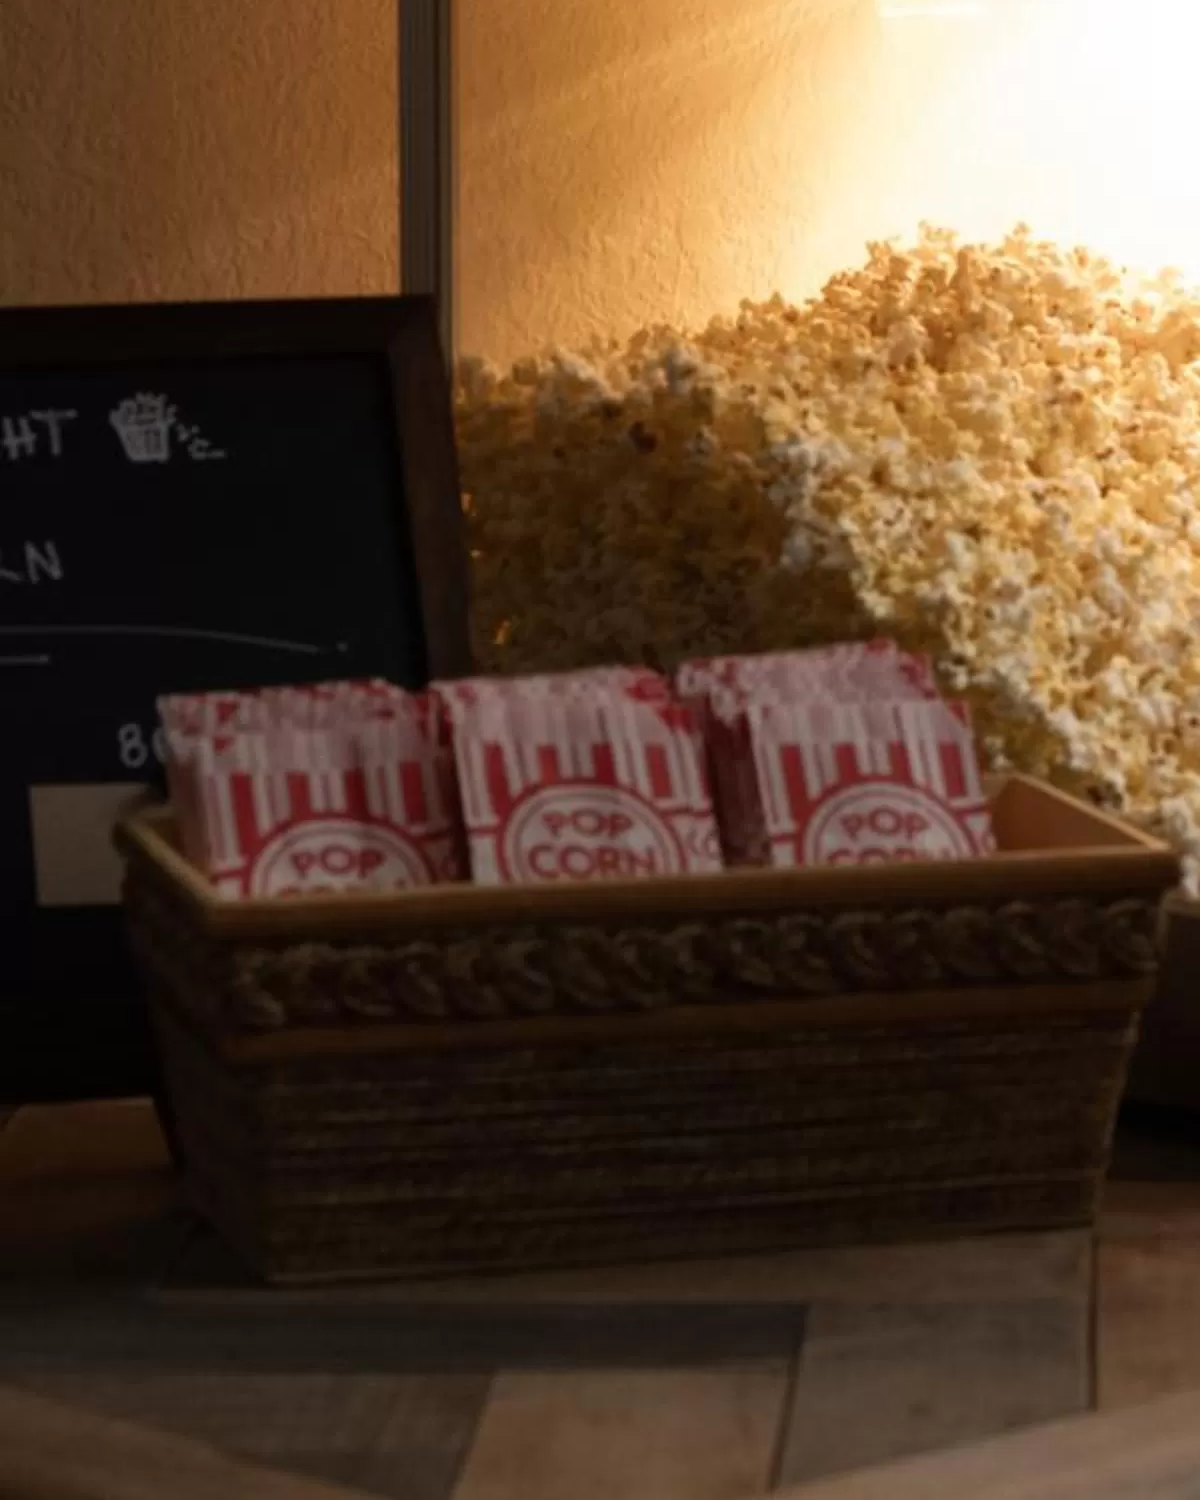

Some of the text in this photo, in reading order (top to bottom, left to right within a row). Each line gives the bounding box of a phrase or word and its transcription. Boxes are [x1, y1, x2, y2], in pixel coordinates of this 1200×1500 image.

[542, 809, 633, 838] POP
[841, 806, 930, 842] POP
[290, 845, 387, 879] POP
[528, 845, 656, 877] CORN
